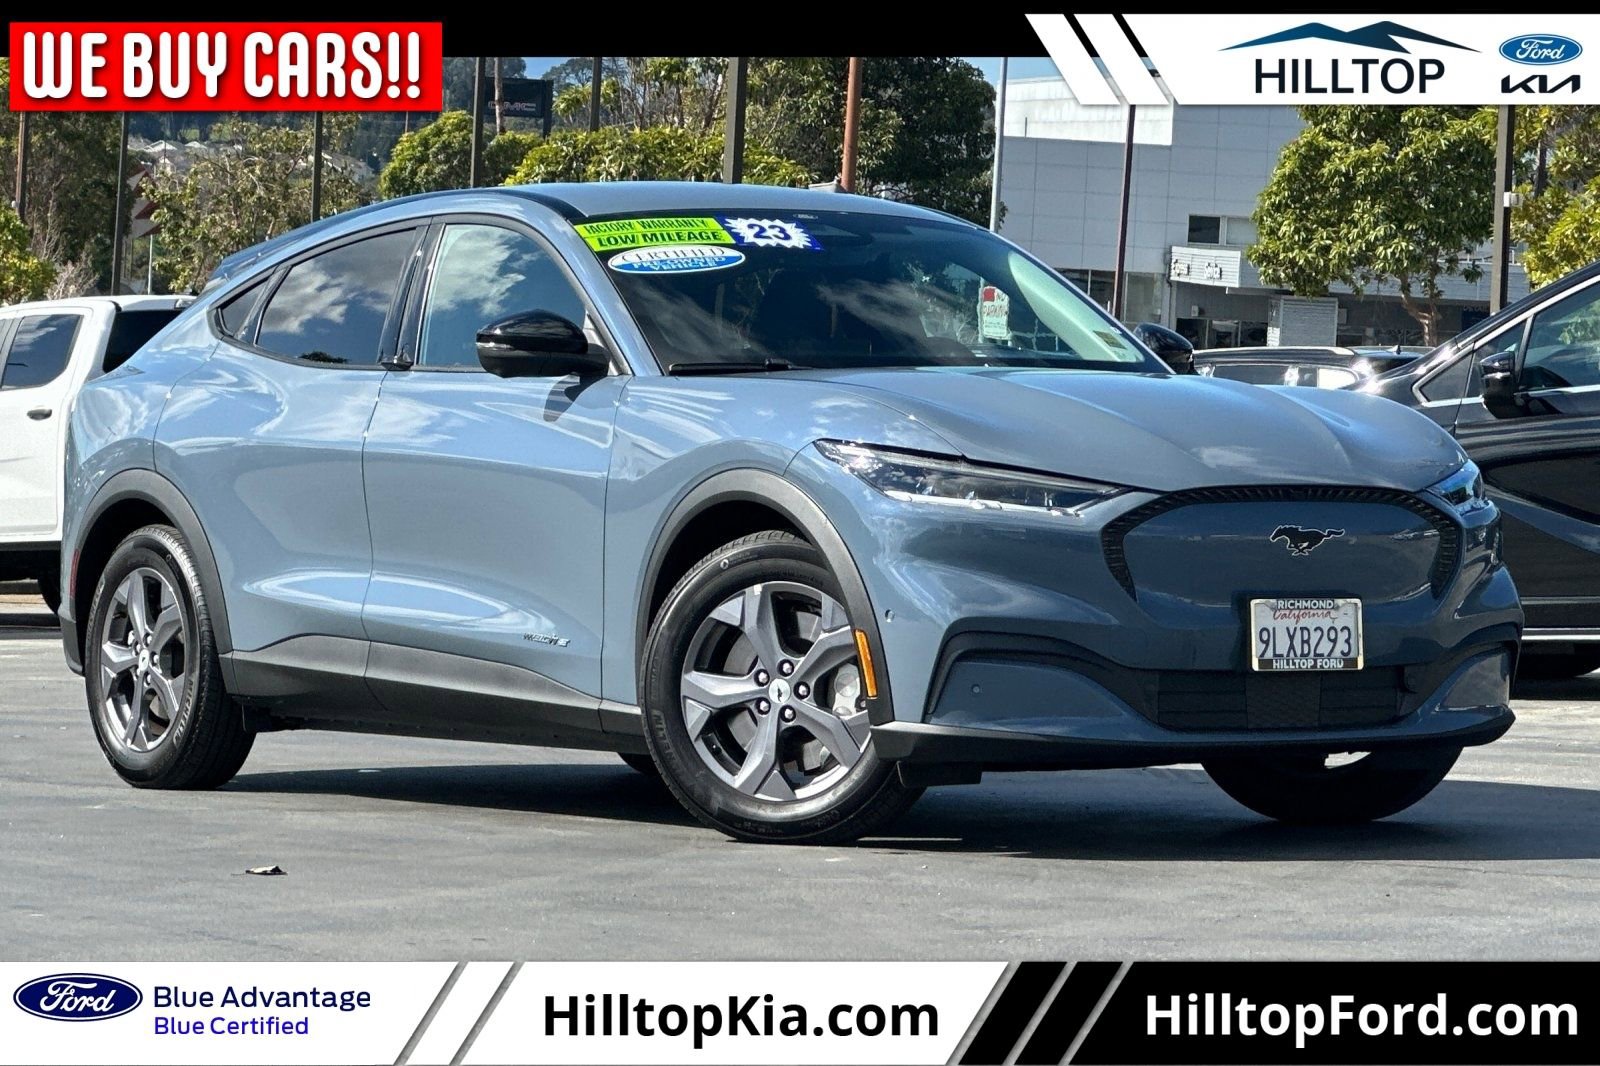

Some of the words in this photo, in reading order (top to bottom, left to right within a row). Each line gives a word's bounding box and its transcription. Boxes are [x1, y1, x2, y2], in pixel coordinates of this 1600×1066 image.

[584, 221, 634, 235] FACTORY
[637, 219, 707, 230] WARRANTY
[747, 223, 793, 242] 23
[597, 234, 637, 247] LOW
[641, 231, 722, 243] MILEAGE
[1277, 600, 1334, 609] RICHMOND
[1273, 608, 1338, 625] California
[1258, 626, 1352, 658] 9LXB293
[1273, 658, 1315, 669] HILLTOP
[1317, 658, 1344, 669] FORD
